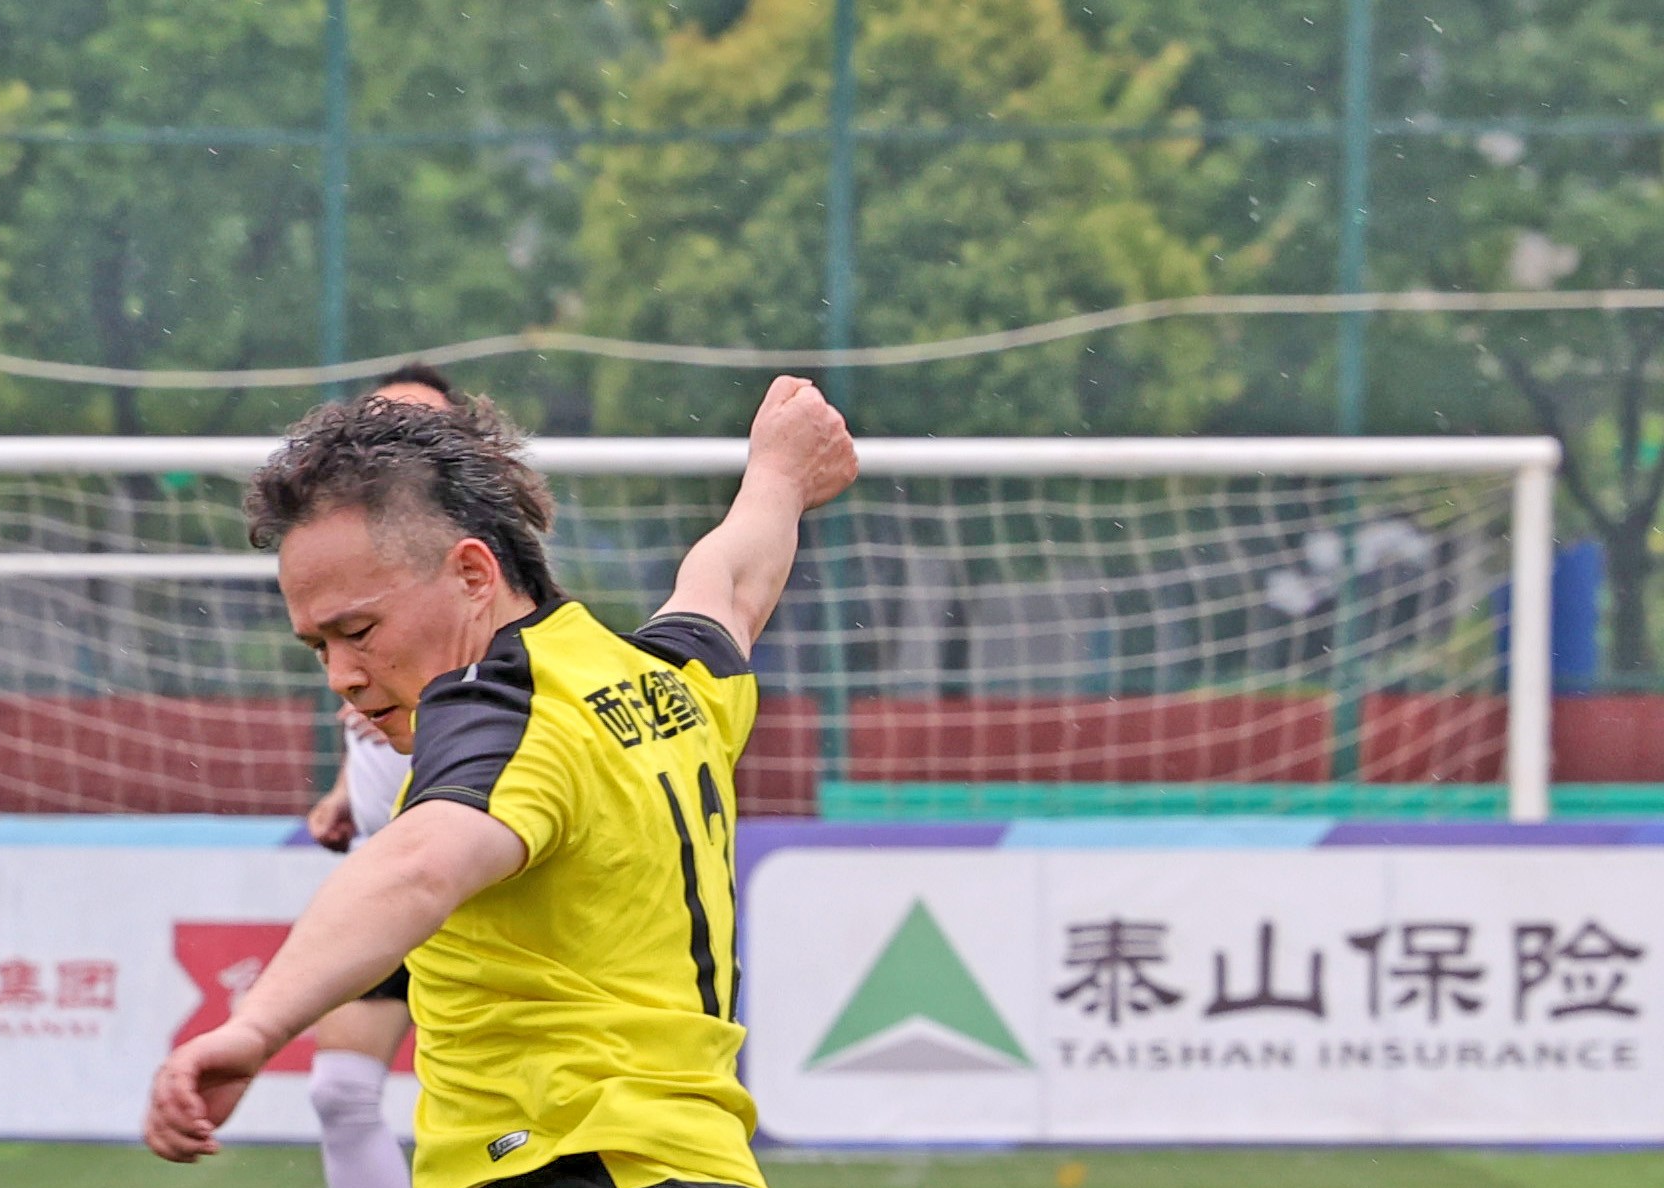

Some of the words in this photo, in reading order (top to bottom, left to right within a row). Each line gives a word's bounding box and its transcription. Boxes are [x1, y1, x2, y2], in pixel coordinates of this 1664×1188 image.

[1055, 917, 1645, 1024] 泰山保险
[1055, 1039, 1297, 1070] TAISHAN
[1320, 1039, 1641, 1070] INSURANCE
